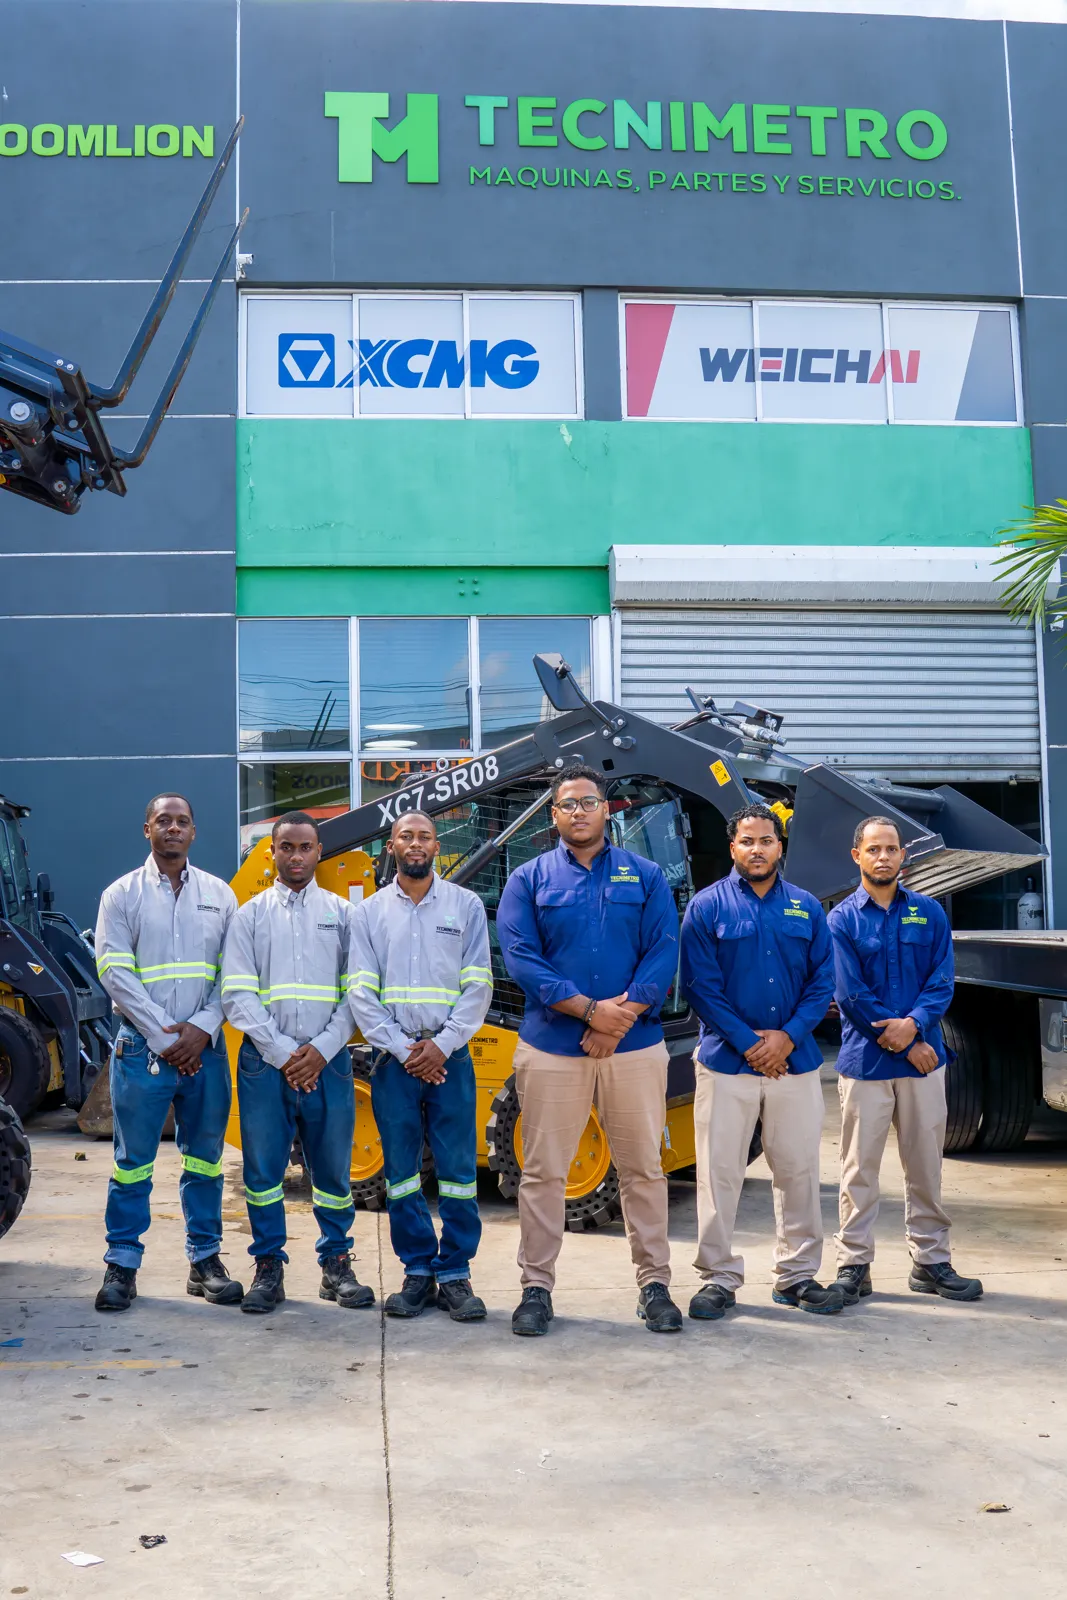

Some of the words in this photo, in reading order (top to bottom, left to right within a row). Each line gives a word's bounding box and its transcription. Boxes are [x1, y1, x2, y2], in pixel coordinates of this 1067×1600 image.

[464, 95, 948, 161] TECNIMETRO
[469, 166, 641, 193] MAQUINAS,
[649, 170, 767, 193] PARTES
[773, 175, 791, 194] Y
[797, 174, 963, 201] SERVICIOS.
[335, 338, 540, 390] XCMG
[699, 347, 921, 384] WEICHAI
[377, 755, 500, 828] XC7-SR08
